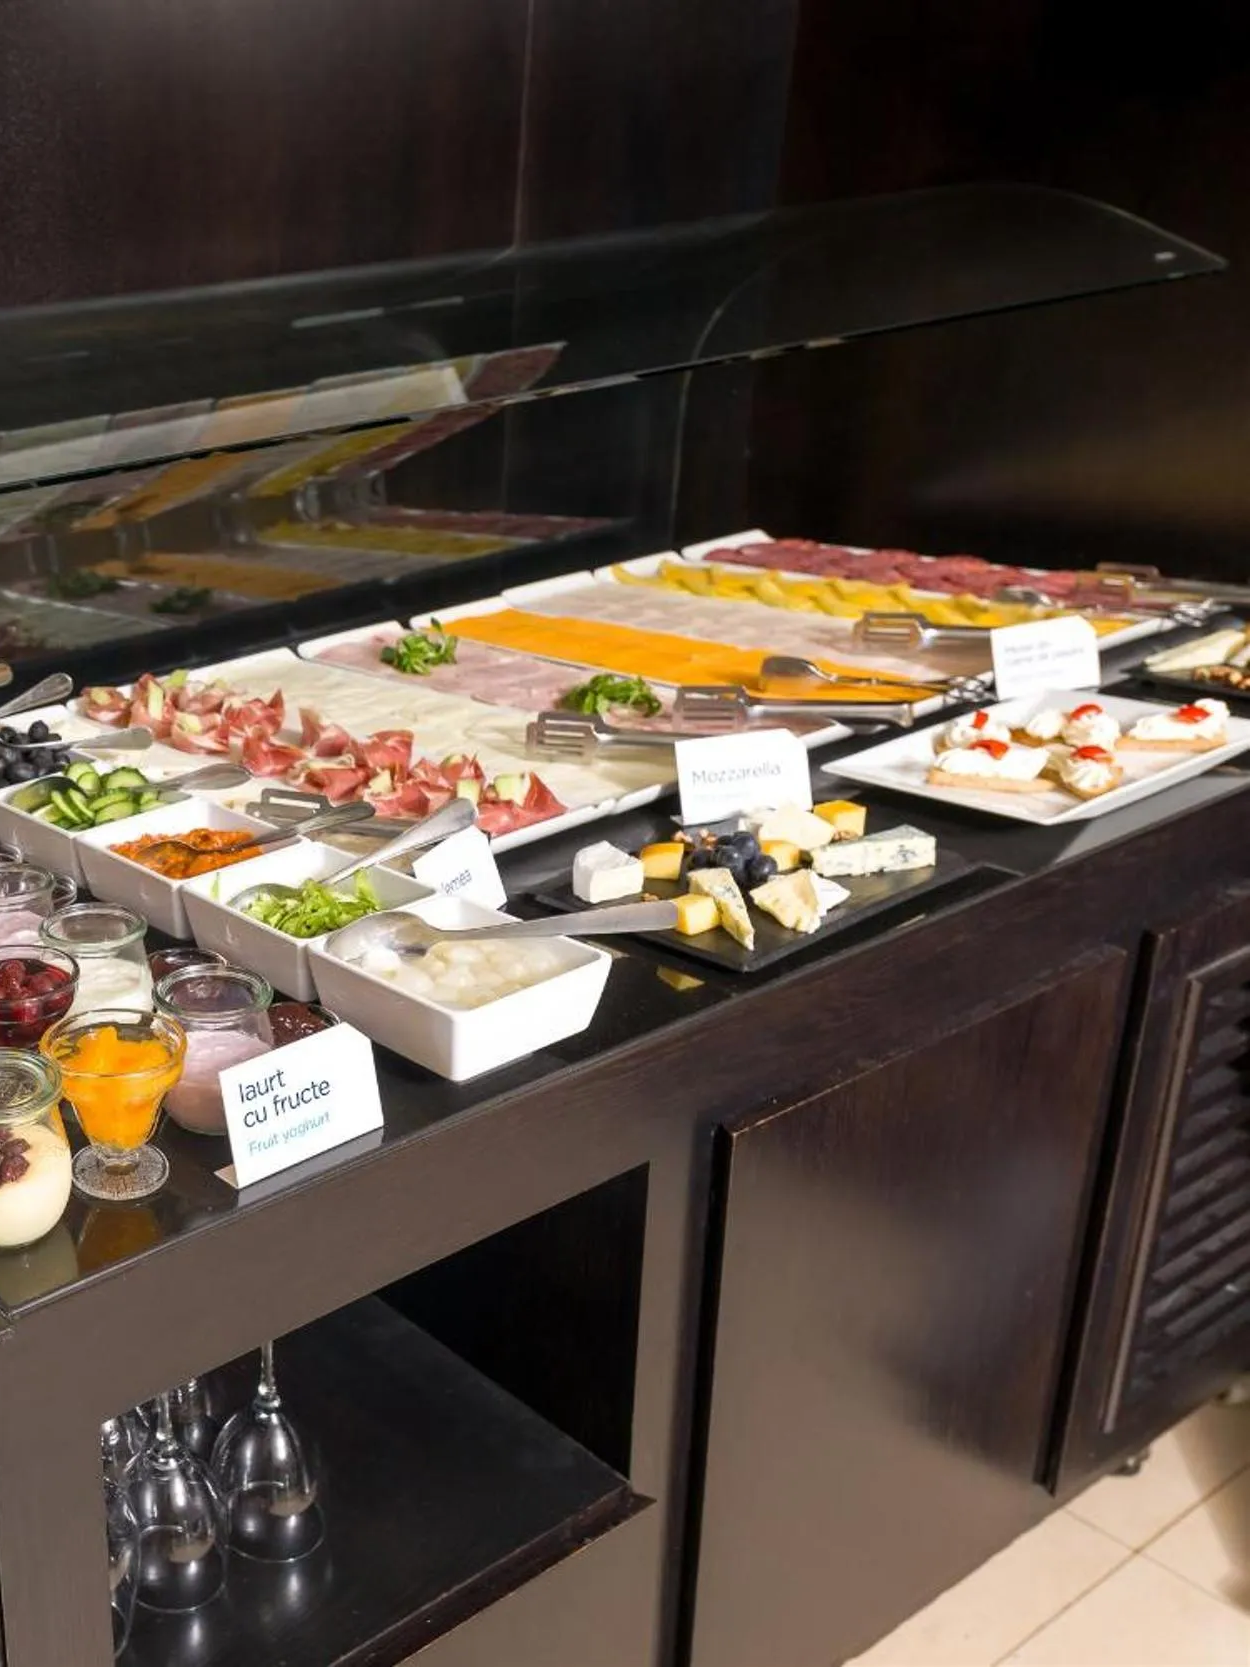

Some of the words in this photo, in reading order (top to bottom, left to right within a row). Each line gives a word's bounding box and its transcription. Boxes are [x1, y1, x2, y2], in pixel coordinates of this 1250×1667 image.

[243, 1105, 268, 1128] cu
[273, 1079, 331, 1116] fructe
[248, 1131, 279, 1156] Fruit
[282, 1111, 331, 1145] yoghurt
